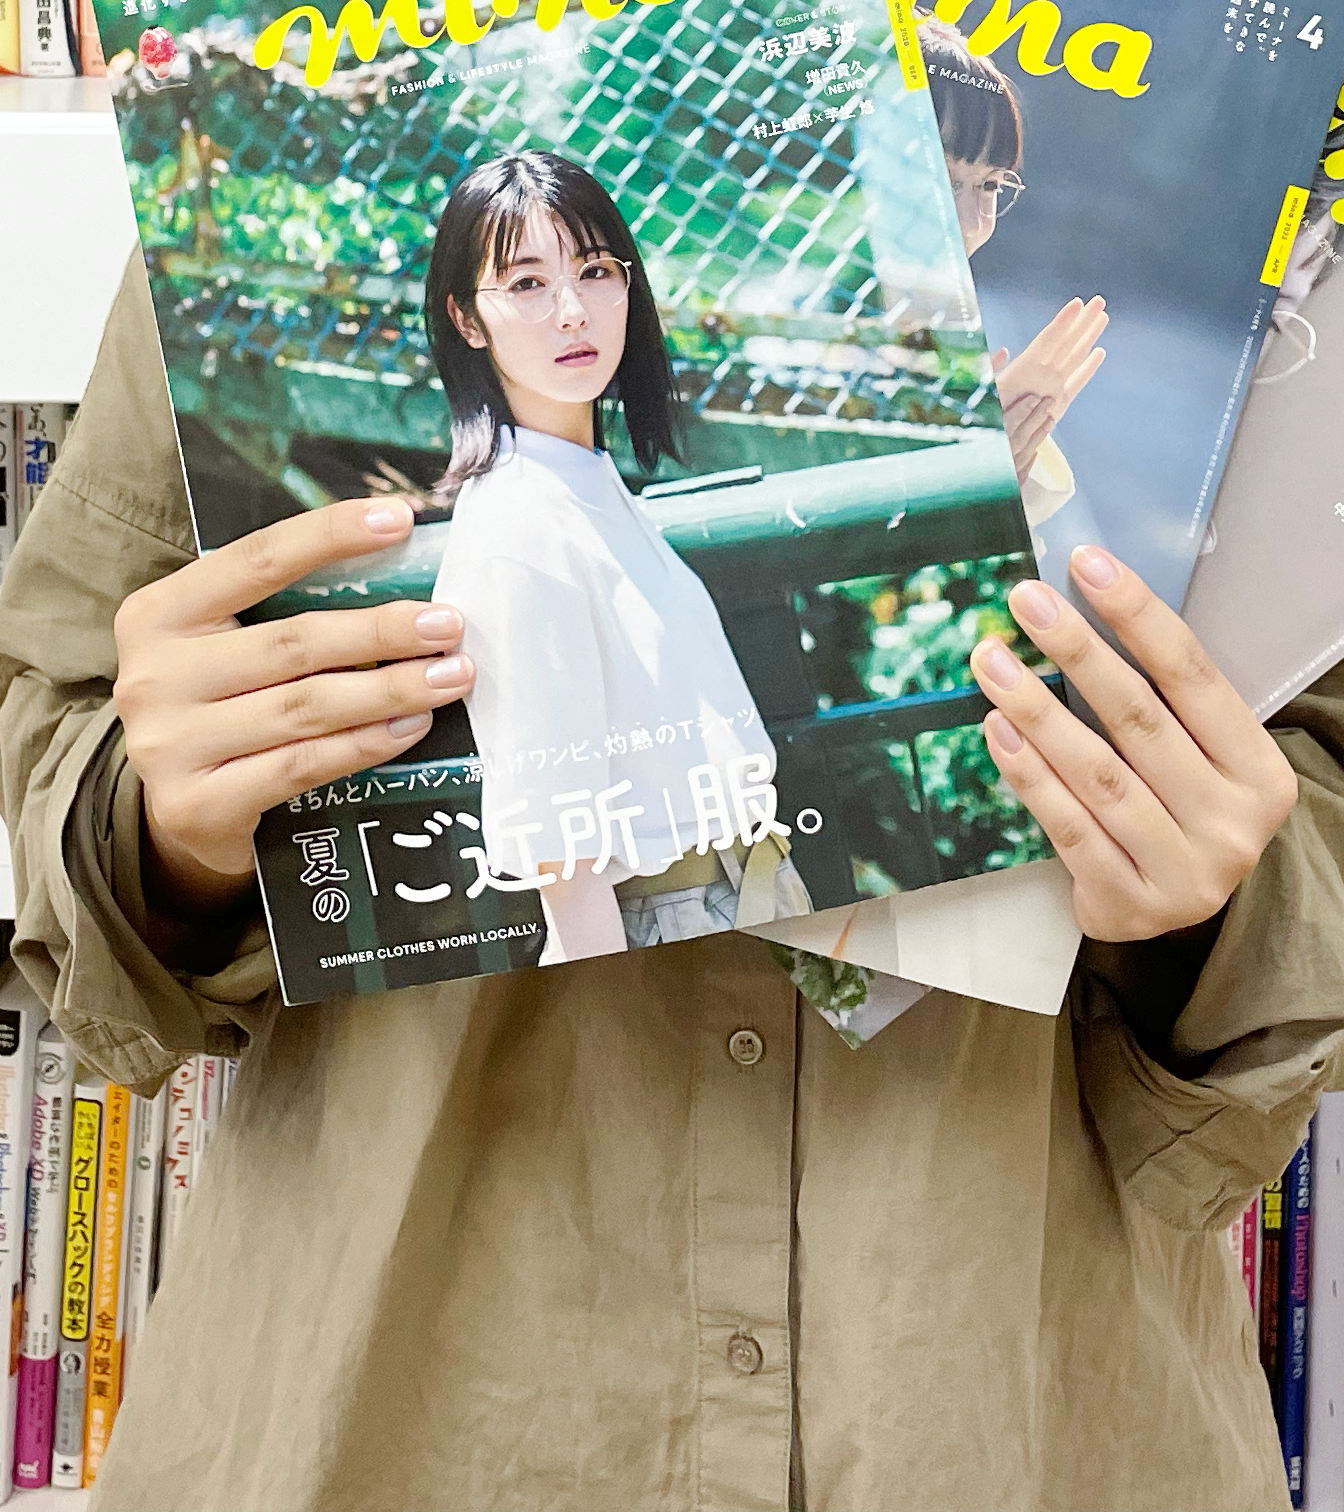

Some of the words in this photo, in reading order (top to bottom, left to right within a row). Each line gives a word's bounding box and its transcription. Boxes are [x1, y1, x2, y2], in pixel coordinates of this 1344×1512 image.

[758, 20, 859, 64] 浜辺美波
[1296, 13, 1325, 51] 4
[391, 74, 445, 97] FASHION
[446, 73, 457, 85] &
[458, 59, 524, 82] LIFESTYLE
[526, 43, 592, 67] MAGAZINE
[804, 58, 868, 87] 増田貴久
[938, 65, 1007, 97] MAGAZINE
[355, 753, 826, 904] 「ご近所」服。
[291, 826, 353, 924] 夏の
[319, 949, 375, 970] SUMMER
[376, 940, 436, 961] CLOTHES
[436, 933, 478, 951] WORN
[478, 922, 543, 944] LOCALLY.
